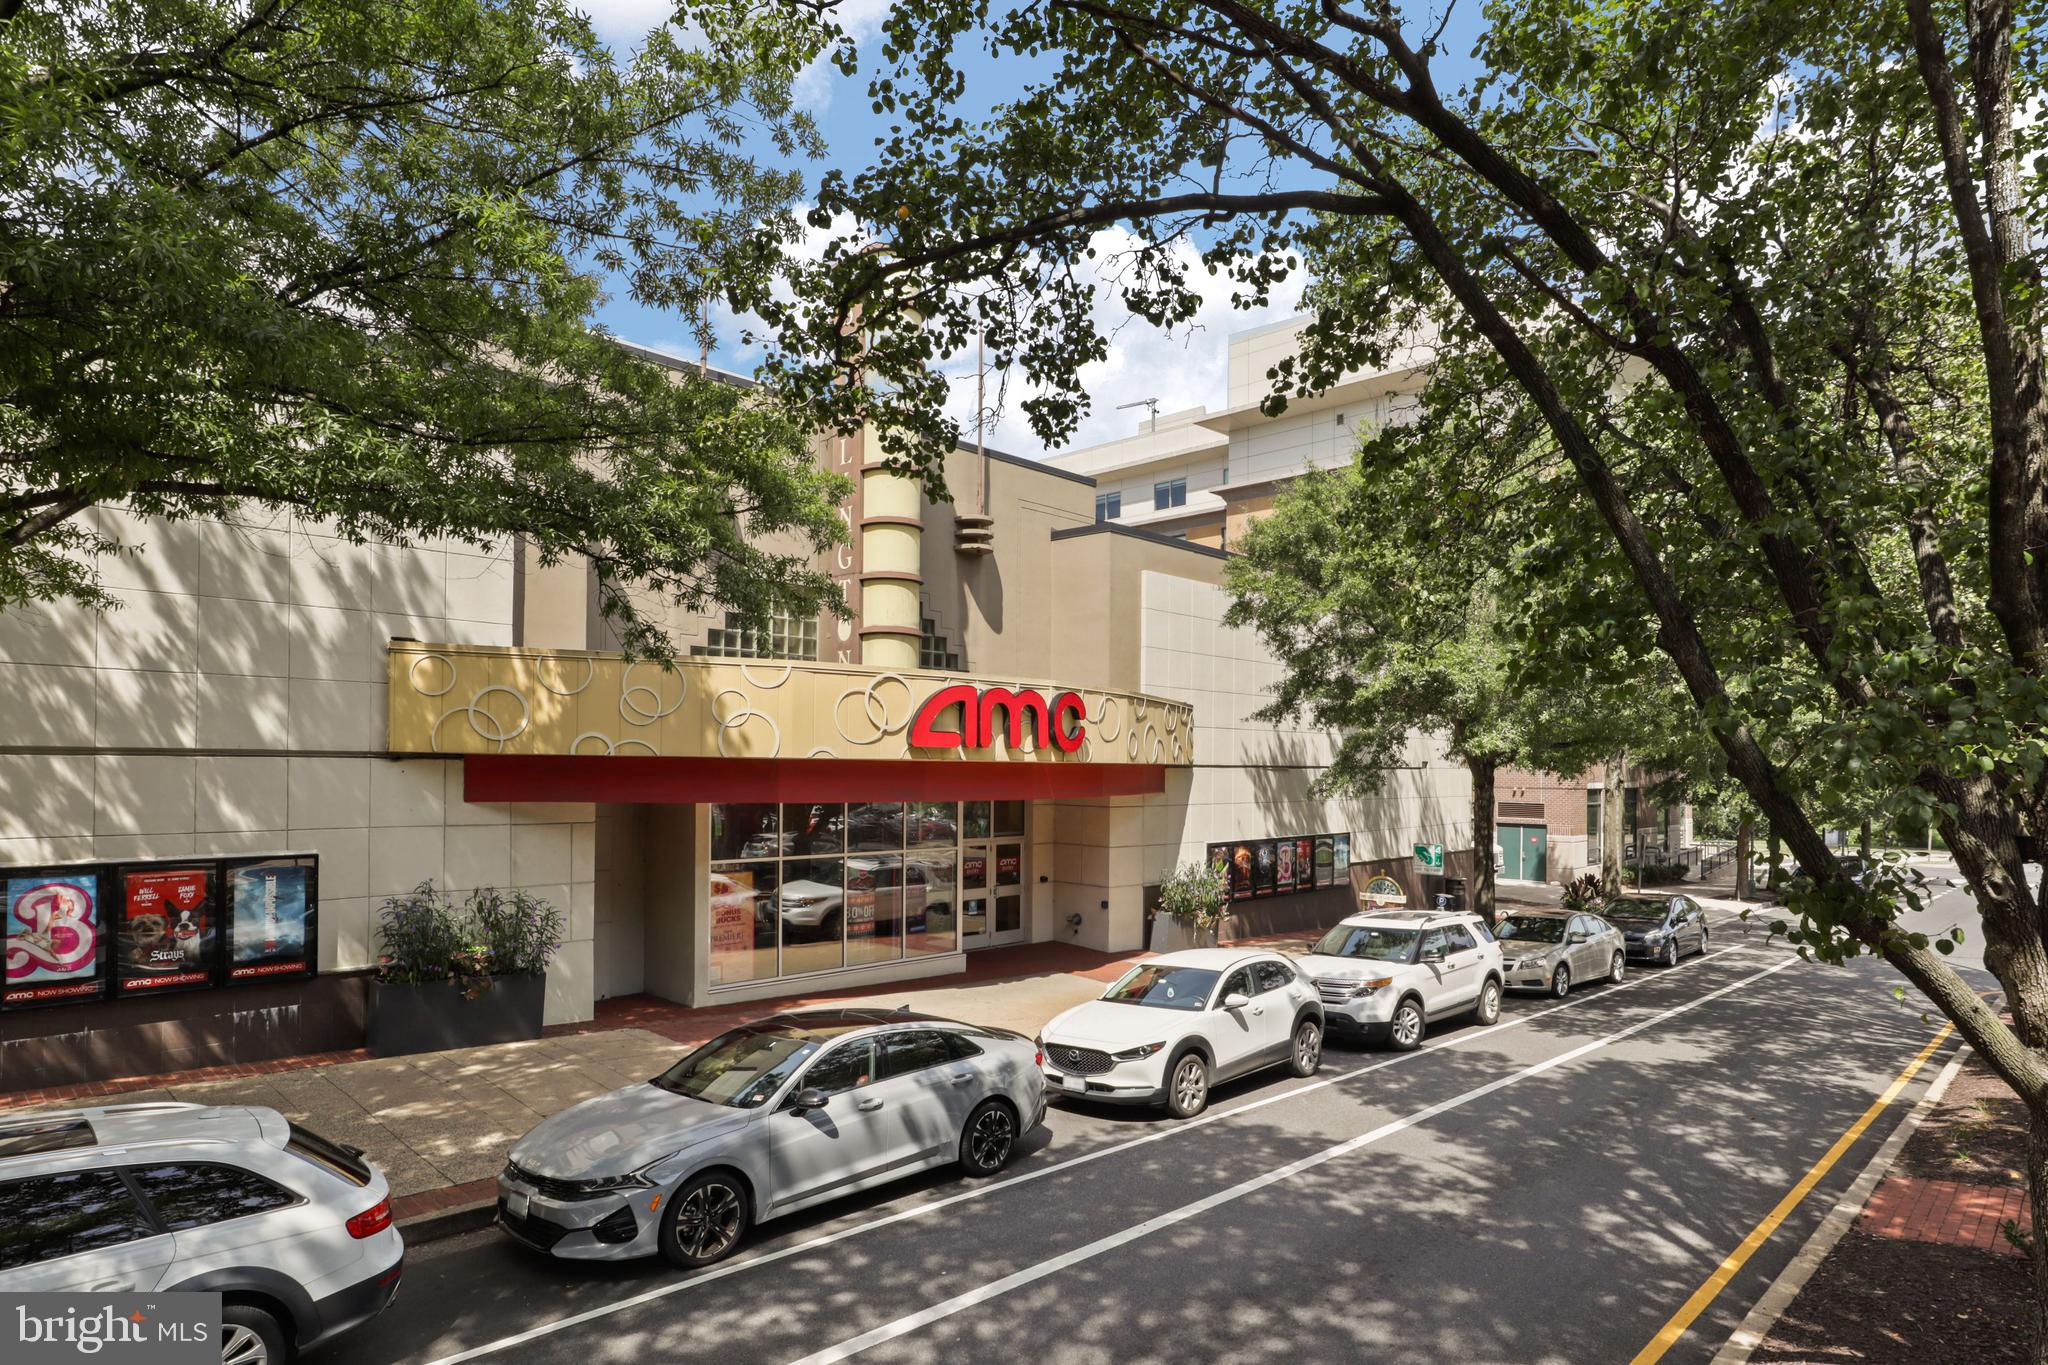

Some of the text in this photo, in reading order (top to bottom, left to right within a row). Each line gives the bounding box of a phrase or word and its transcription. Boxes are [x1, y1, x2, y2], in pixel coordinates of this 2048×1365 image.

[150, 950, 185, 962] Strays
[173, 973, 206, 982] SHOWING
[37, 989, 58, 997] NOW
[58, 985, 96, 995] SHOWING
